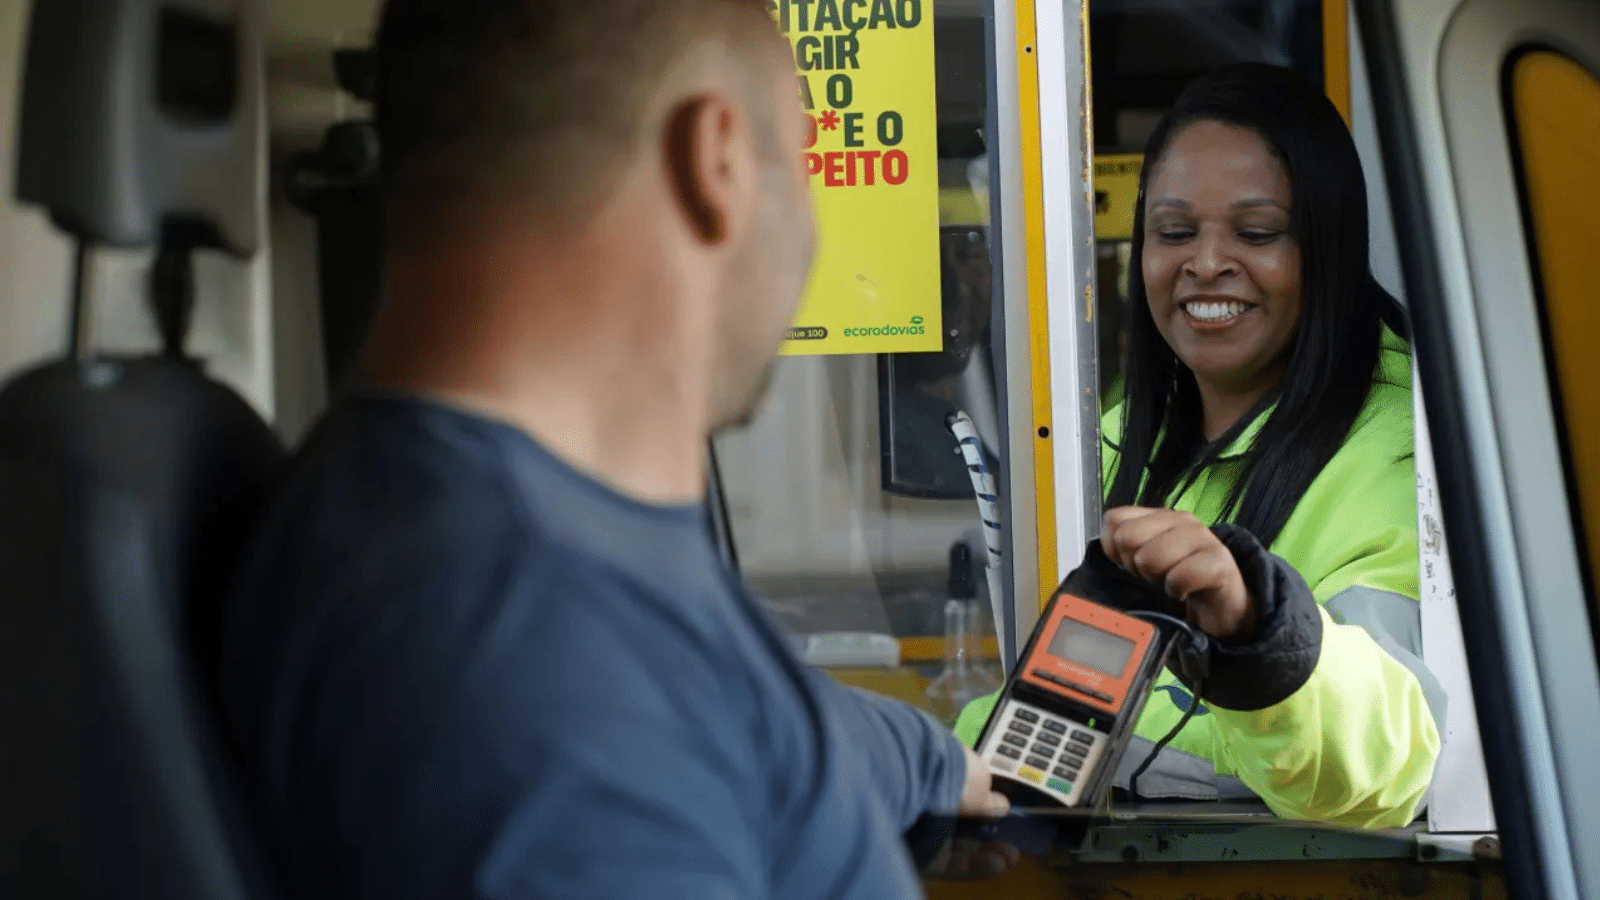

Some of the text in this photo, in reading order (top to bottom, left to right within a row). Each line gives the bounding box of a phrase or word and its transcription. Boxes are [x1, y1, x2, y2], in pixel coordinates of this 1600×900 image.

[826, 74, 853, 109] O
[843, 112, 864, 148] E
[877, 111, 903, 146] O
[807, 329, 824, 337] 100
[843, 324, 925, 337] ecorodovias
